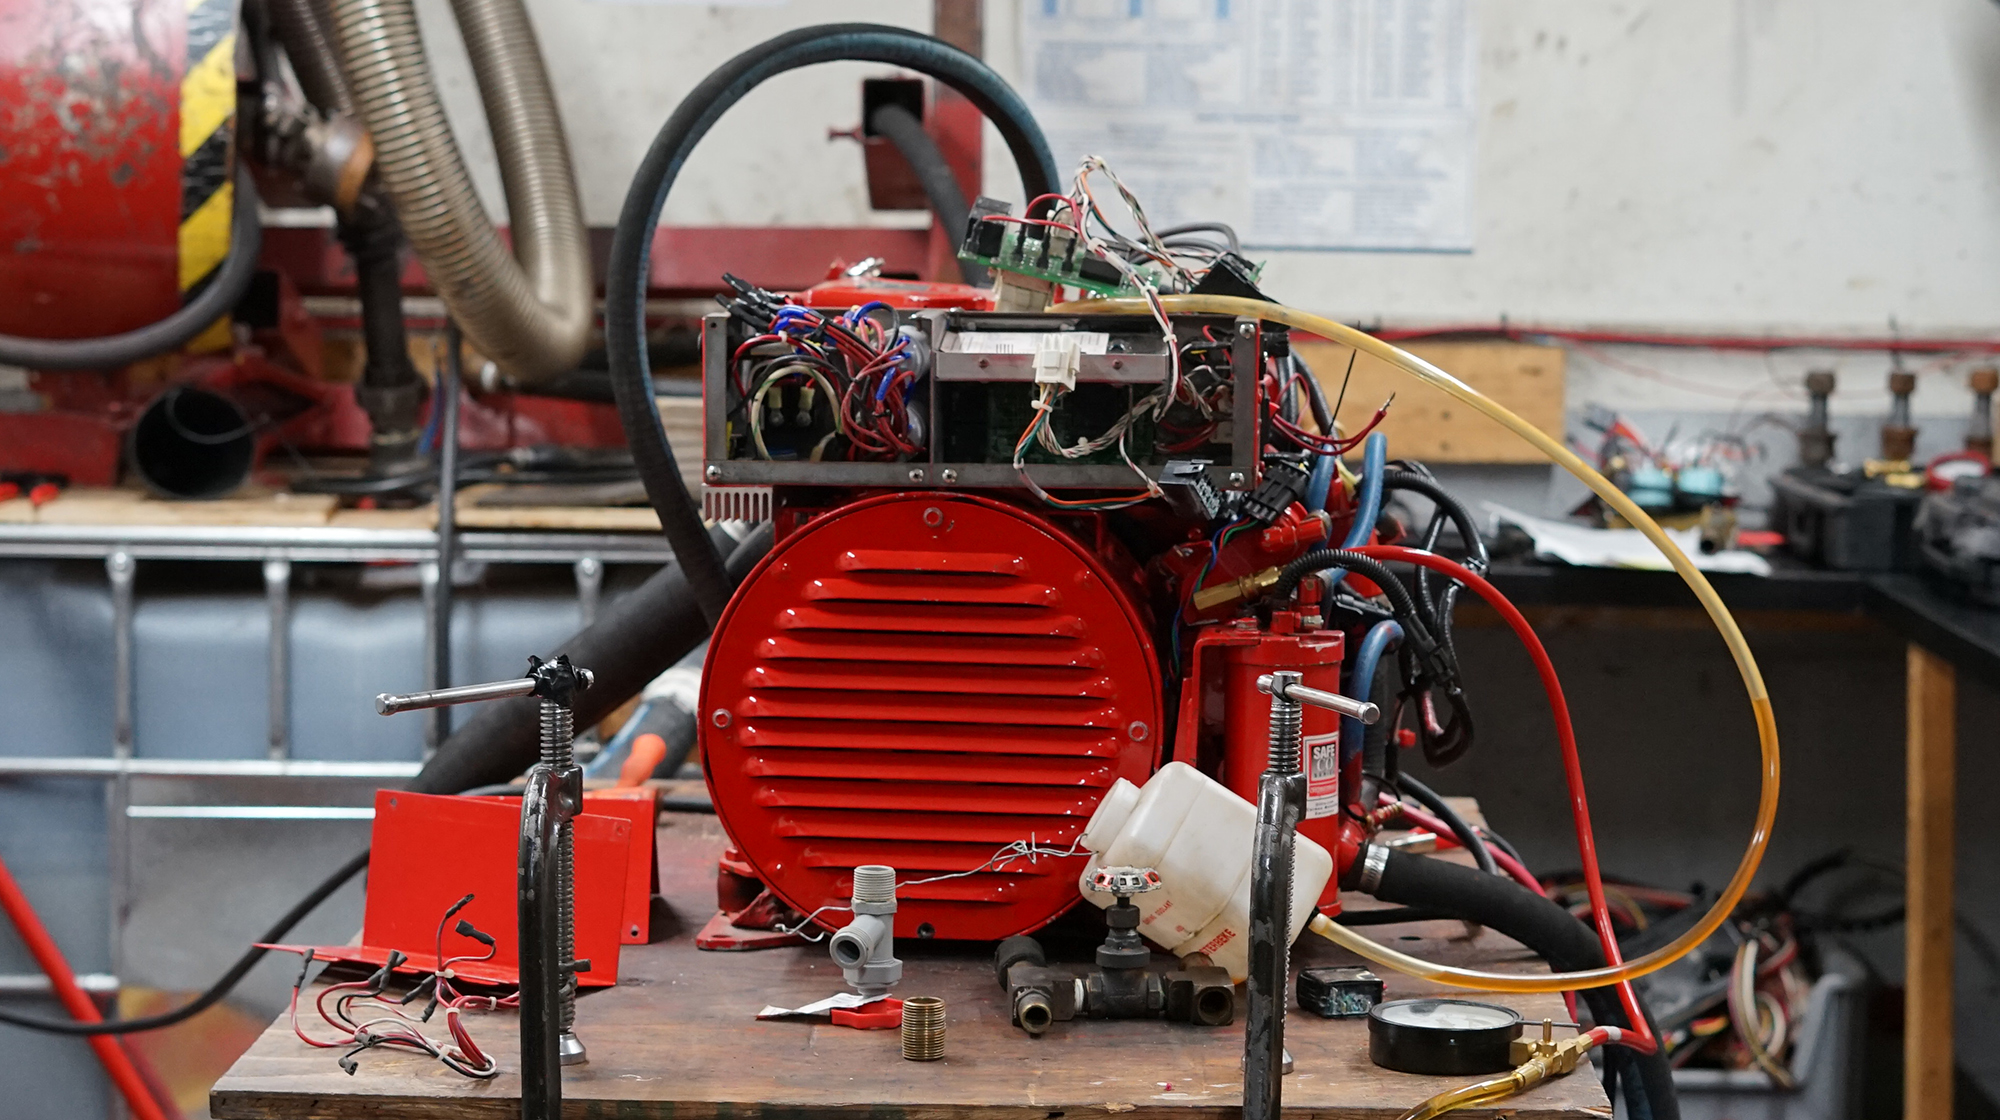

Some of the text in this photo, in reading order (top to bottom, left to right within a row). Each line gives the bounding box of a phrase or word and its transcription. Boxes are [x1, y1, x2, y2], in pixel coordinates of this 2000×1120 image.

[1313, 744, 1335, 760] SAFE
[1317, 757, 1333, 772] CO
[1198, 928, 1236, 956] STERBEKE
